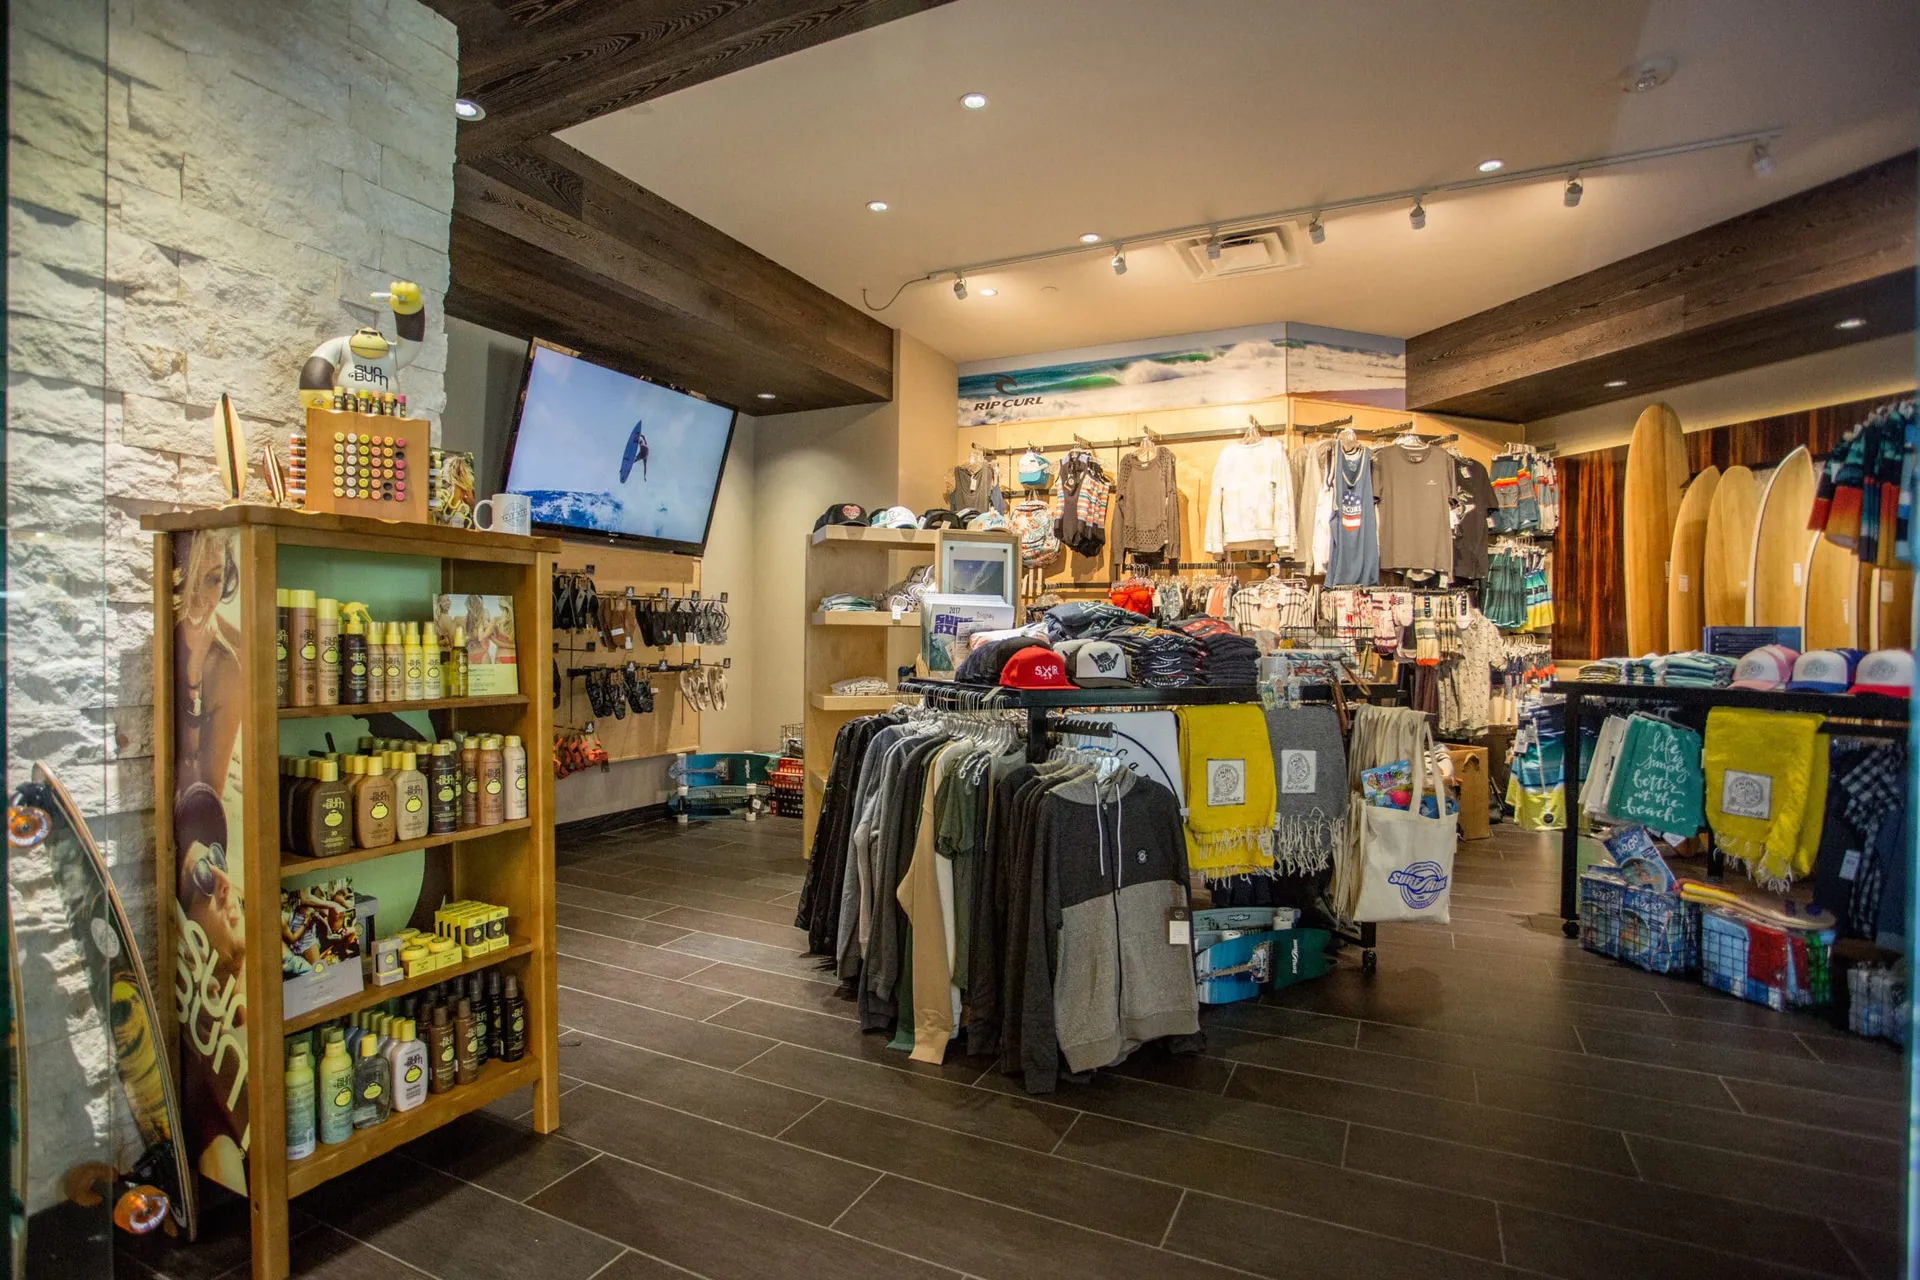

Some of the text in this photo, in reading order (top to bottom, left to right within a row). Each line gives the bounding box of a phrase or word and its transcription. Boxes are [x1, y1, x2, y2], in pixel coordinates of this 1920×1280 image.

[973, 396, 1044, 411] RIP CURL
[1648, 731, 1681, 764] life
[1636, 753, 1690, 783] simply
[1633, 769, 1686, 796] better
[1621, 797, 1686, 823] beach
[1634, 789, 1684, 808] at the
